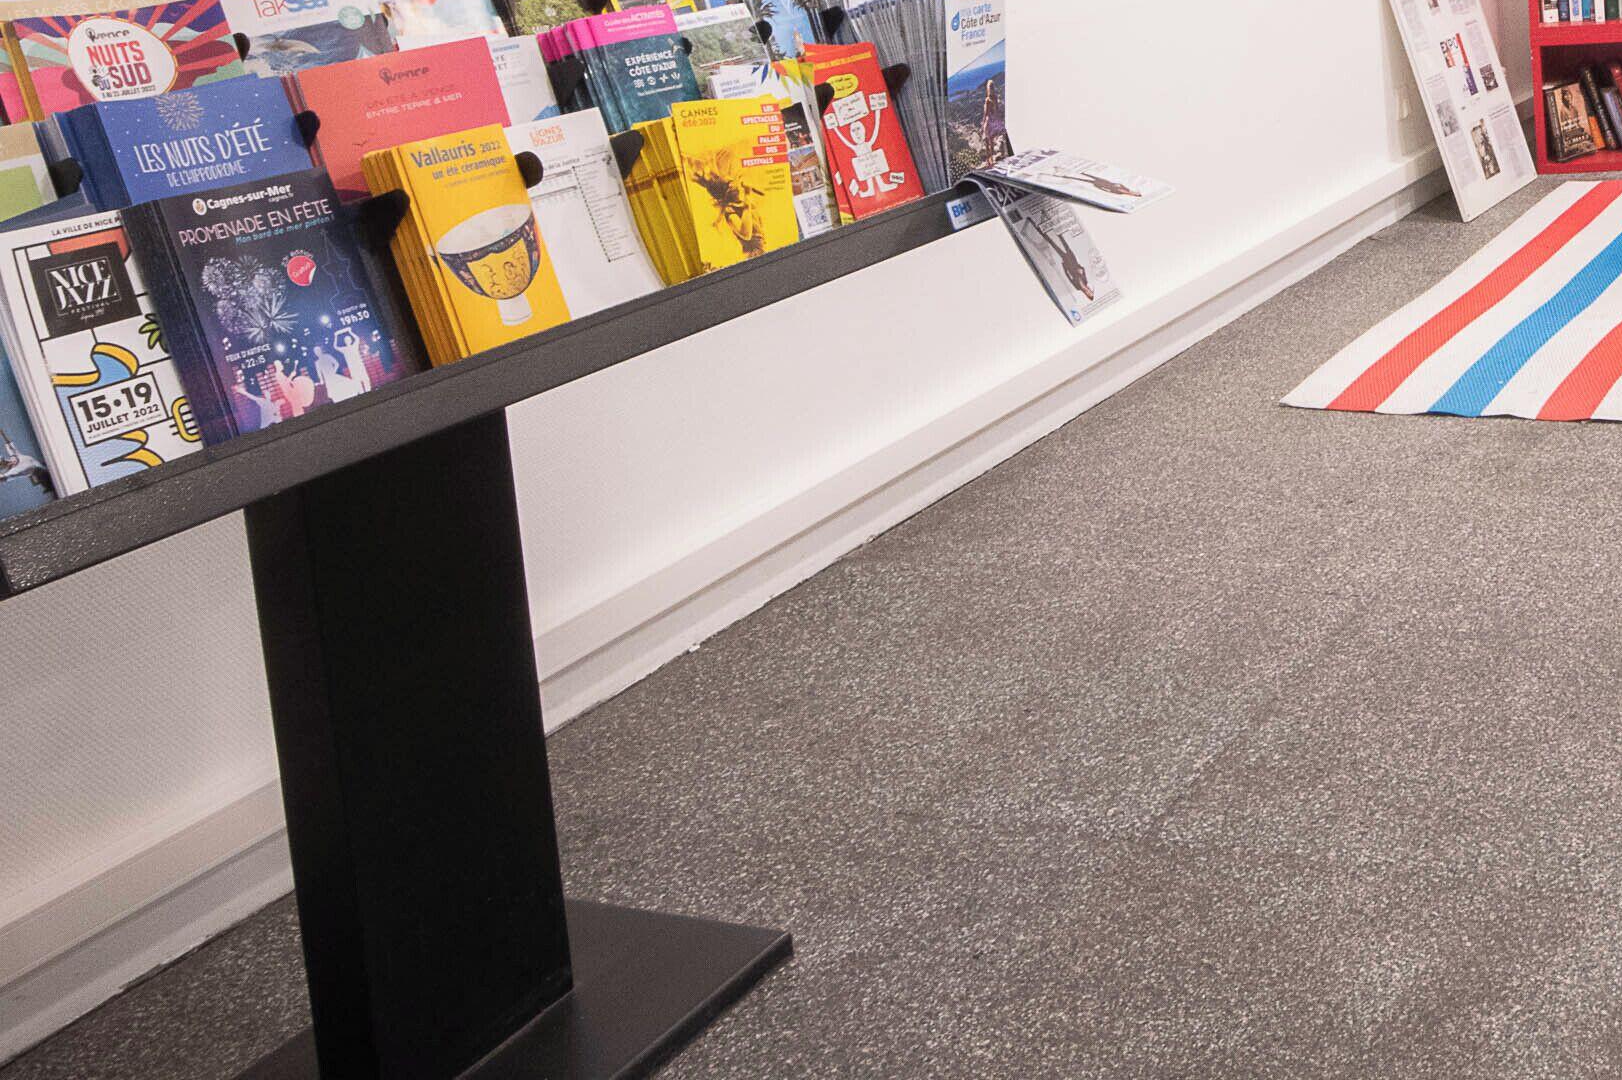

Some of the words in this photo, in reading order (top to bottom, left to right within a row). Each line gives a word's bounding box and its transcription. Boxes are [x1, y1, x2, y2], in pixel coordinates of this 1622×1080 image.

[960, 16, 978, 30] Côte
[979, 13, 1001, 26] d'Azur
[960, 28, 986, 40] France
[86, 40, 145, 68] NUITS
[625, 50, 675, 67] EXPÉRIENCE
[108, 62, 152, 88] SUD
[629, 66, 652, 78] CÔTE
[652, 60, 677, 73] D'AZUR
[680, 107, 718, 119] CANNES
[742, 115, 779, 124] SPECTACLES
[133, 143, 167, 173] LES
[163, 136, 216, 170] NUITS
[215, 118, 273, 160] D'ÉTÉ
[411, 139, 477, 169] Vallauris
[166, 172, 182, 188] DE
[179, 159, 248, 186] L'HIPPODROME
[432, 169, 445, 180] un
[446, 166, 460, 177] été
[461, 156, 506, 174] céramique
[206, 183, 292, 210] Cagnes-sur-Mer
[63, 224, 82, 234] VILLE
[83, 222, 93, 230] DE
[178, 214, 266, 248] PROMENADE
[267, 210, 292, 228] EN
[293, 199, 333, 220] FÊTE
[50, 260, 112, 289] NICE
[56, 275, 118, 310] JAZZ
[340, 310, 370, 326] 19h30
[225, 354, 241, 363] FEUX
[86, 412, 130, 433] JUILLET
[133, 404, 160, 418] 2022
